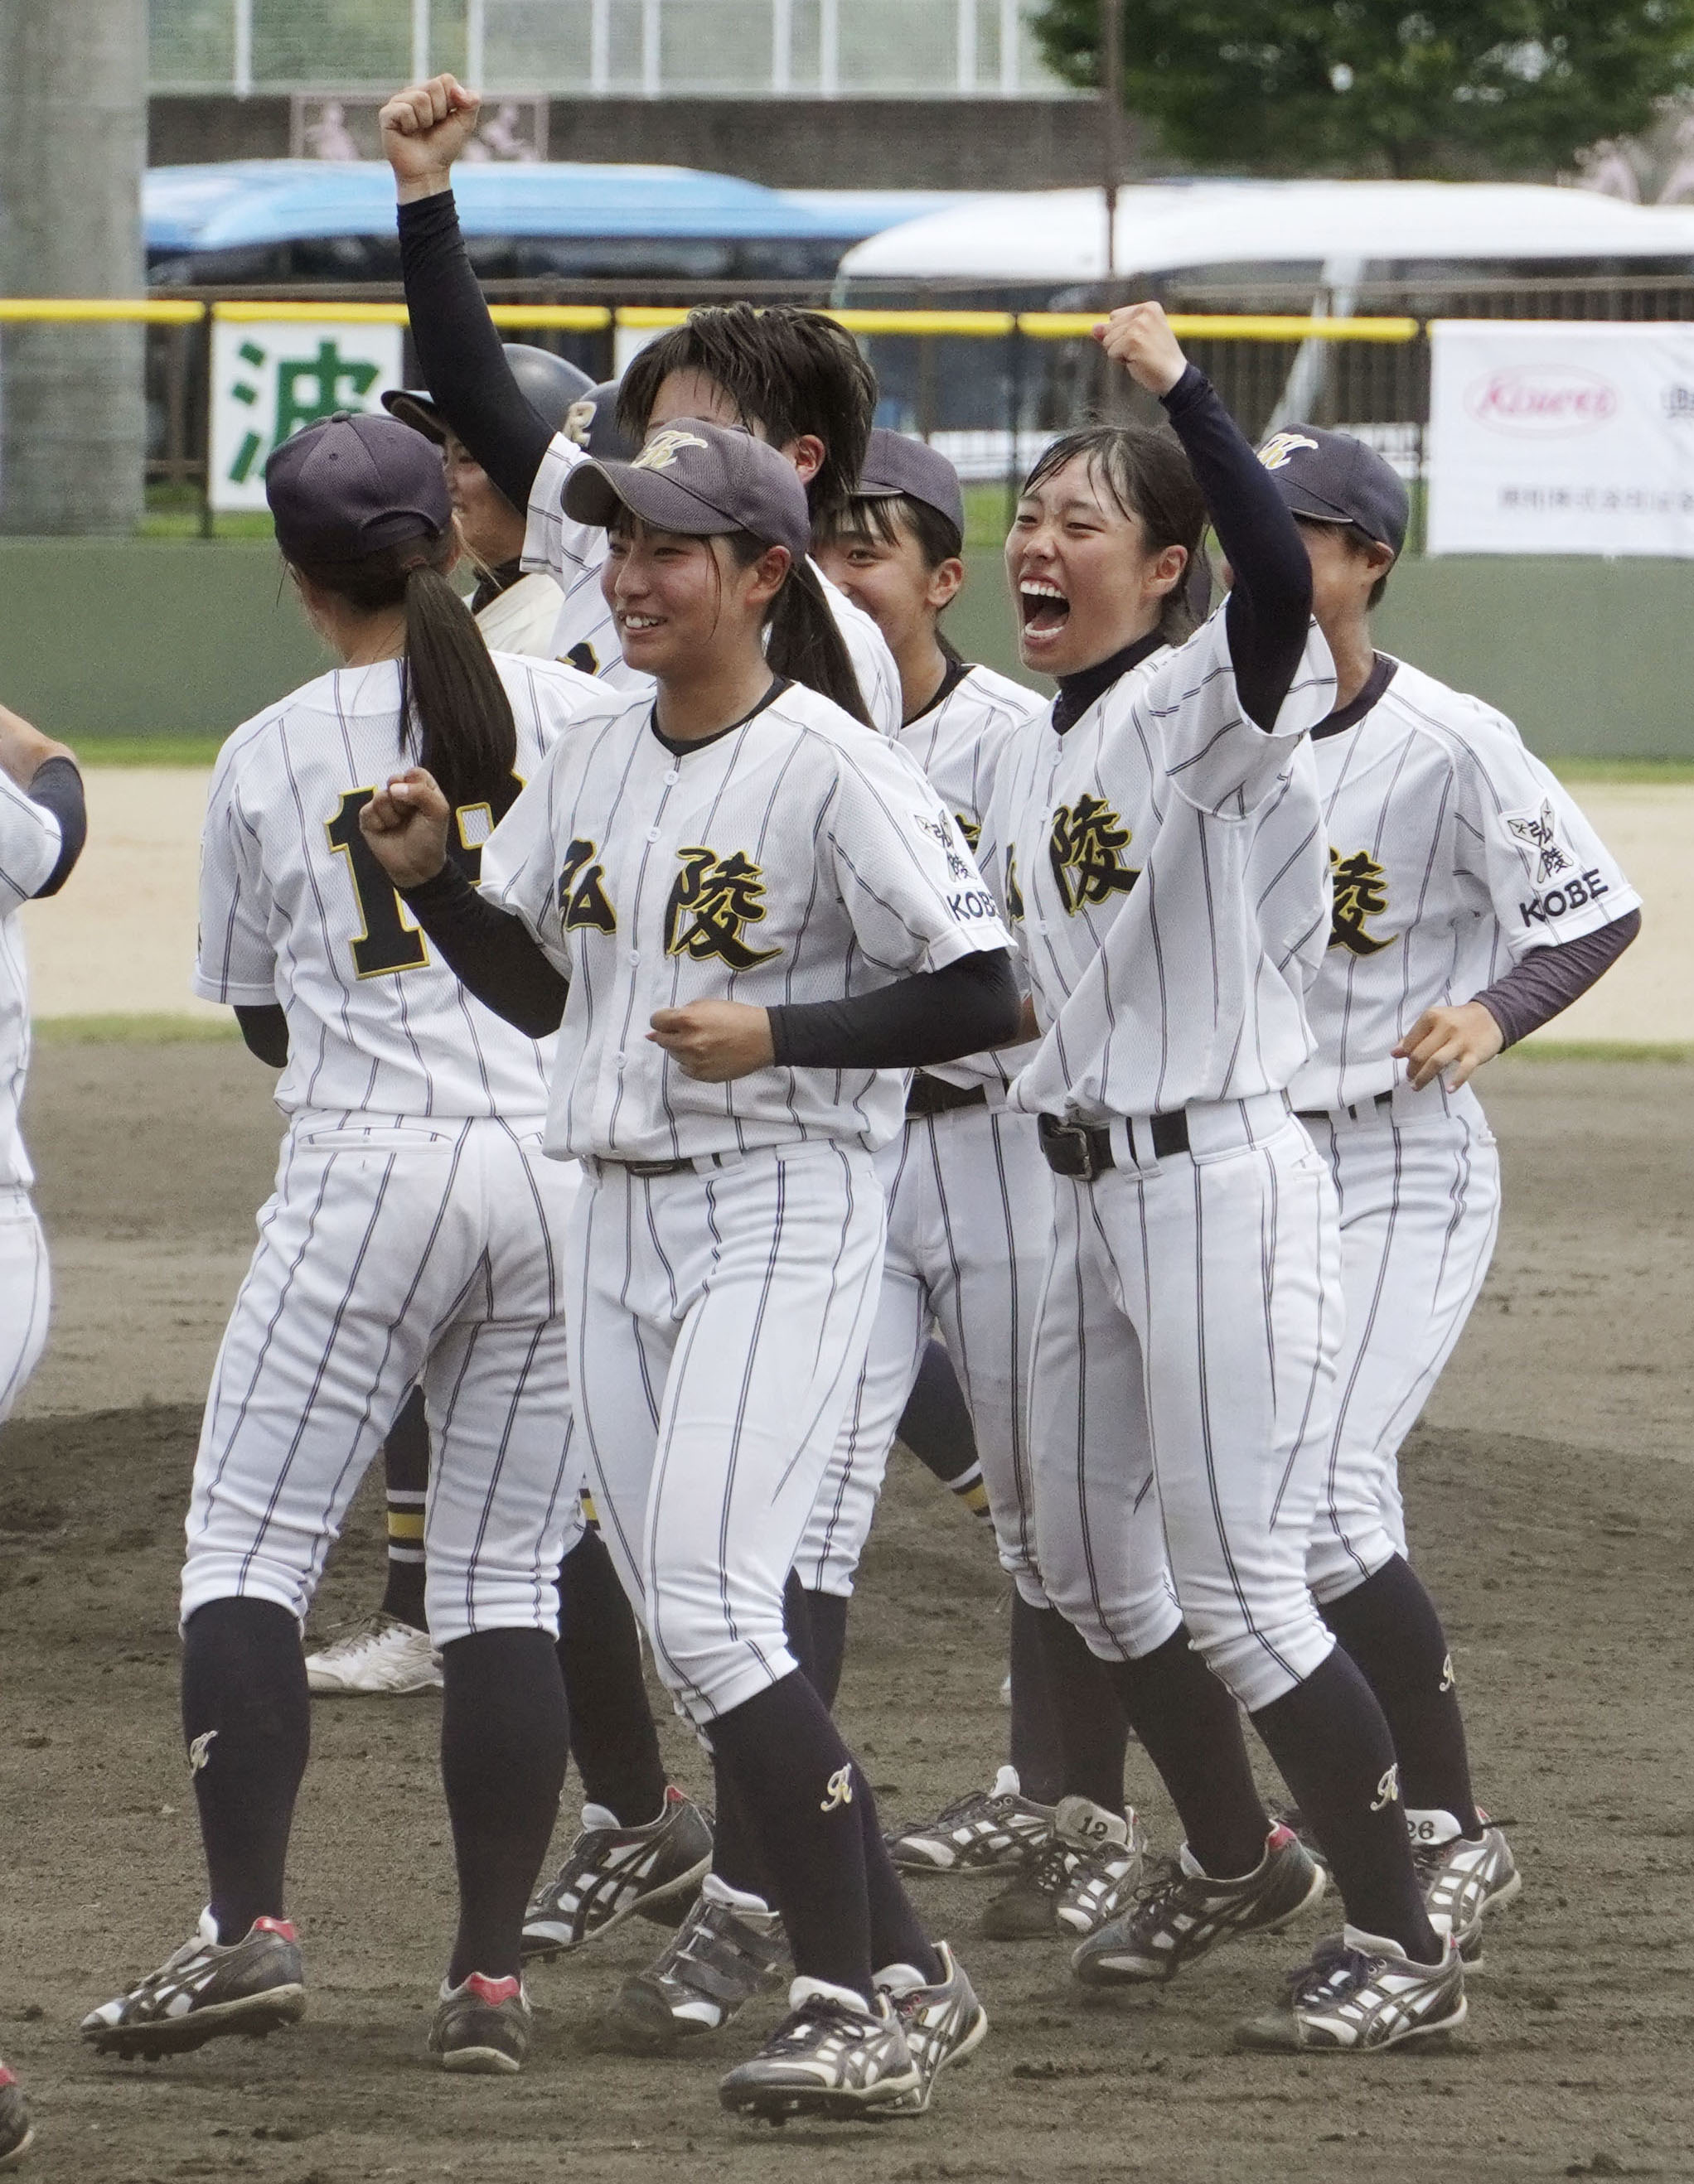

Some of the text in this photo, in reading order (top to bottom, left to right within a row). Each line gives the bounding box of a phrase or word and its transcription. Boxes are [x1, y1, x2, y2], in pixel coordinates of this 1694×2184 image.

[946, 891, 998, 921] KOB
[1519, 867, 1609, 928] KOBE
[1077, 1814, 1109, 1841] 12
[1406, 1819, 1435, 1840] 26
